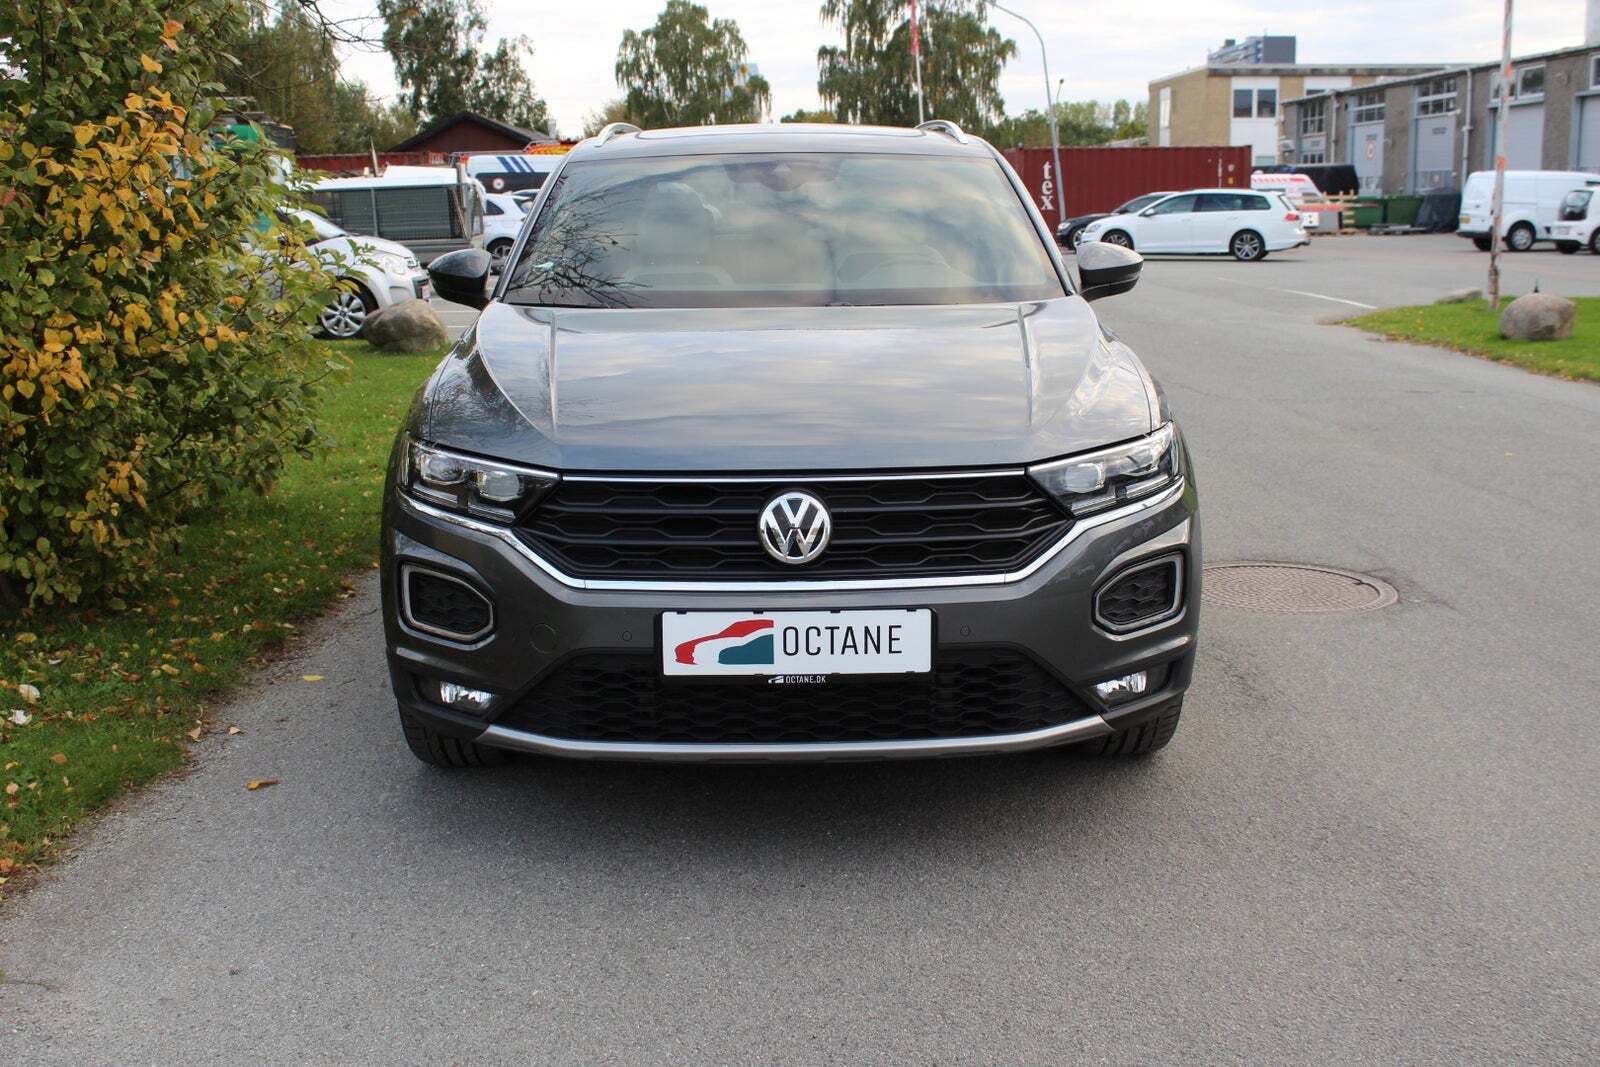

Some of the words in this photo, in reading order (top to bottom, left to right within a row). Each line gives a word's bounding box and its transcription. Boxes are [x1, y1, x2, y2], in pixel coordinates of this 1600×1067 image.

[1041, 161, 1054, 210] tex
[782, 625, 902, 656] OCTANE
[785, 675, 826, 684] OCTANE.DK
